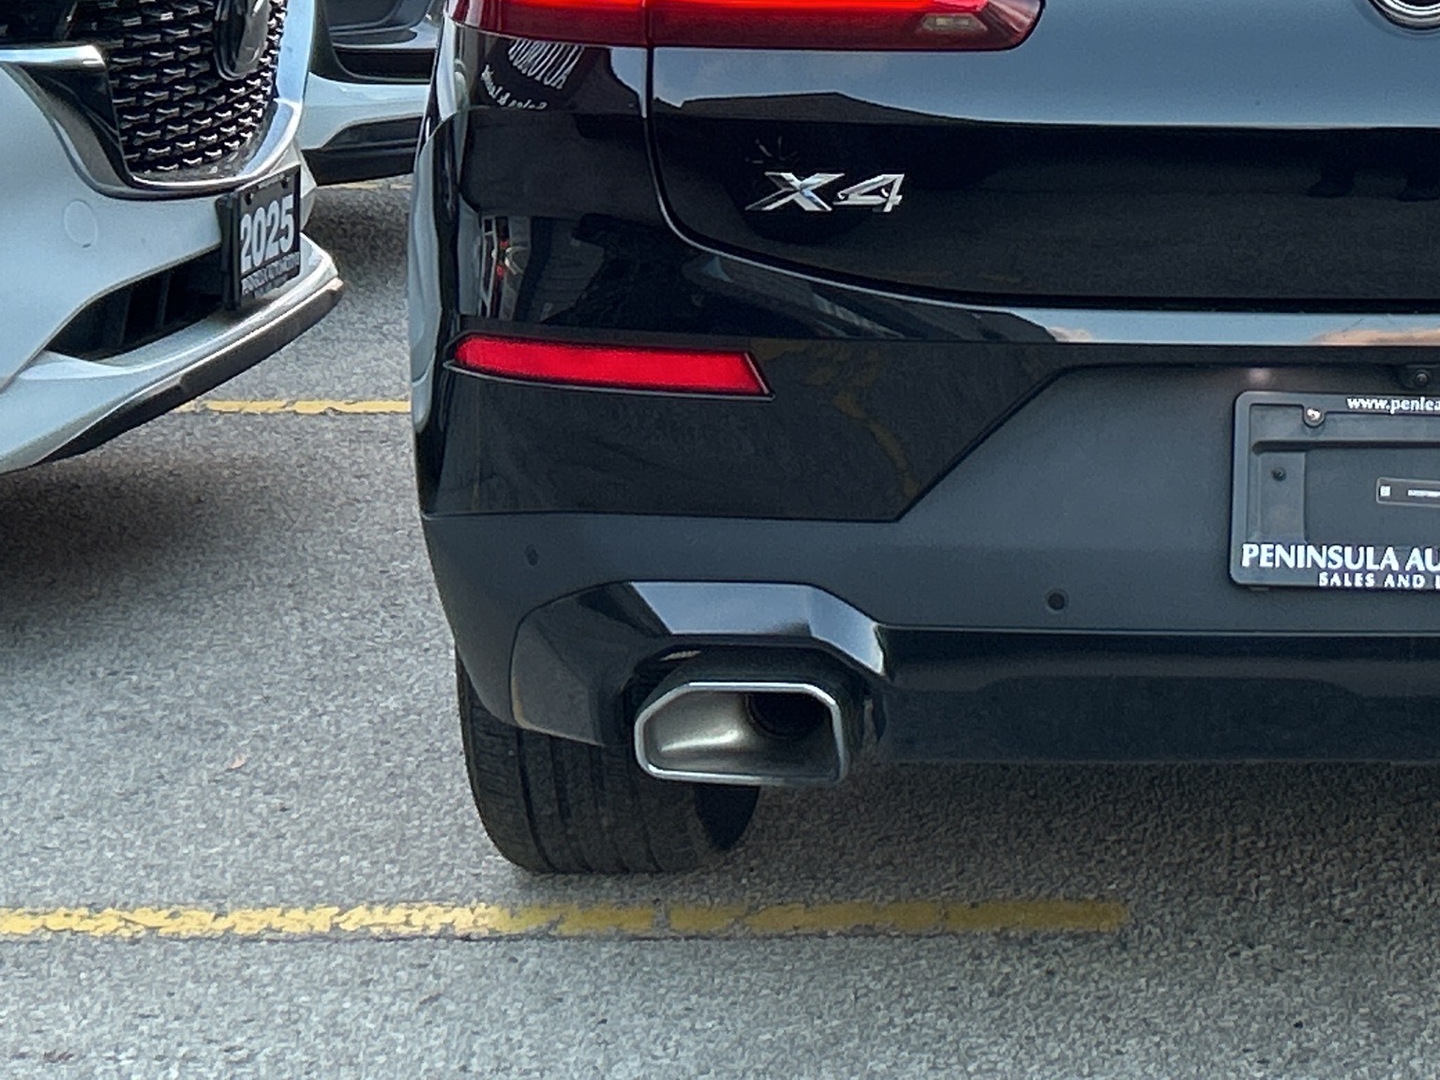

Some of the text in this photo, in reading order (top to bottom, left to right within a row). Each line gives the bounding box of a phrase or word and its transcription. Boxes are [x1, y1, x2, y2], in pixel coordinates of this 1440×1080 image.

[745, 172, 905, 213] X4
[241, 194, 294, 274] 2025
[1241, 543, 1400, 571] PENINSULA
[1319, 572, 1376, 587] SALES
[1384, 573, 1426, 589] AND
